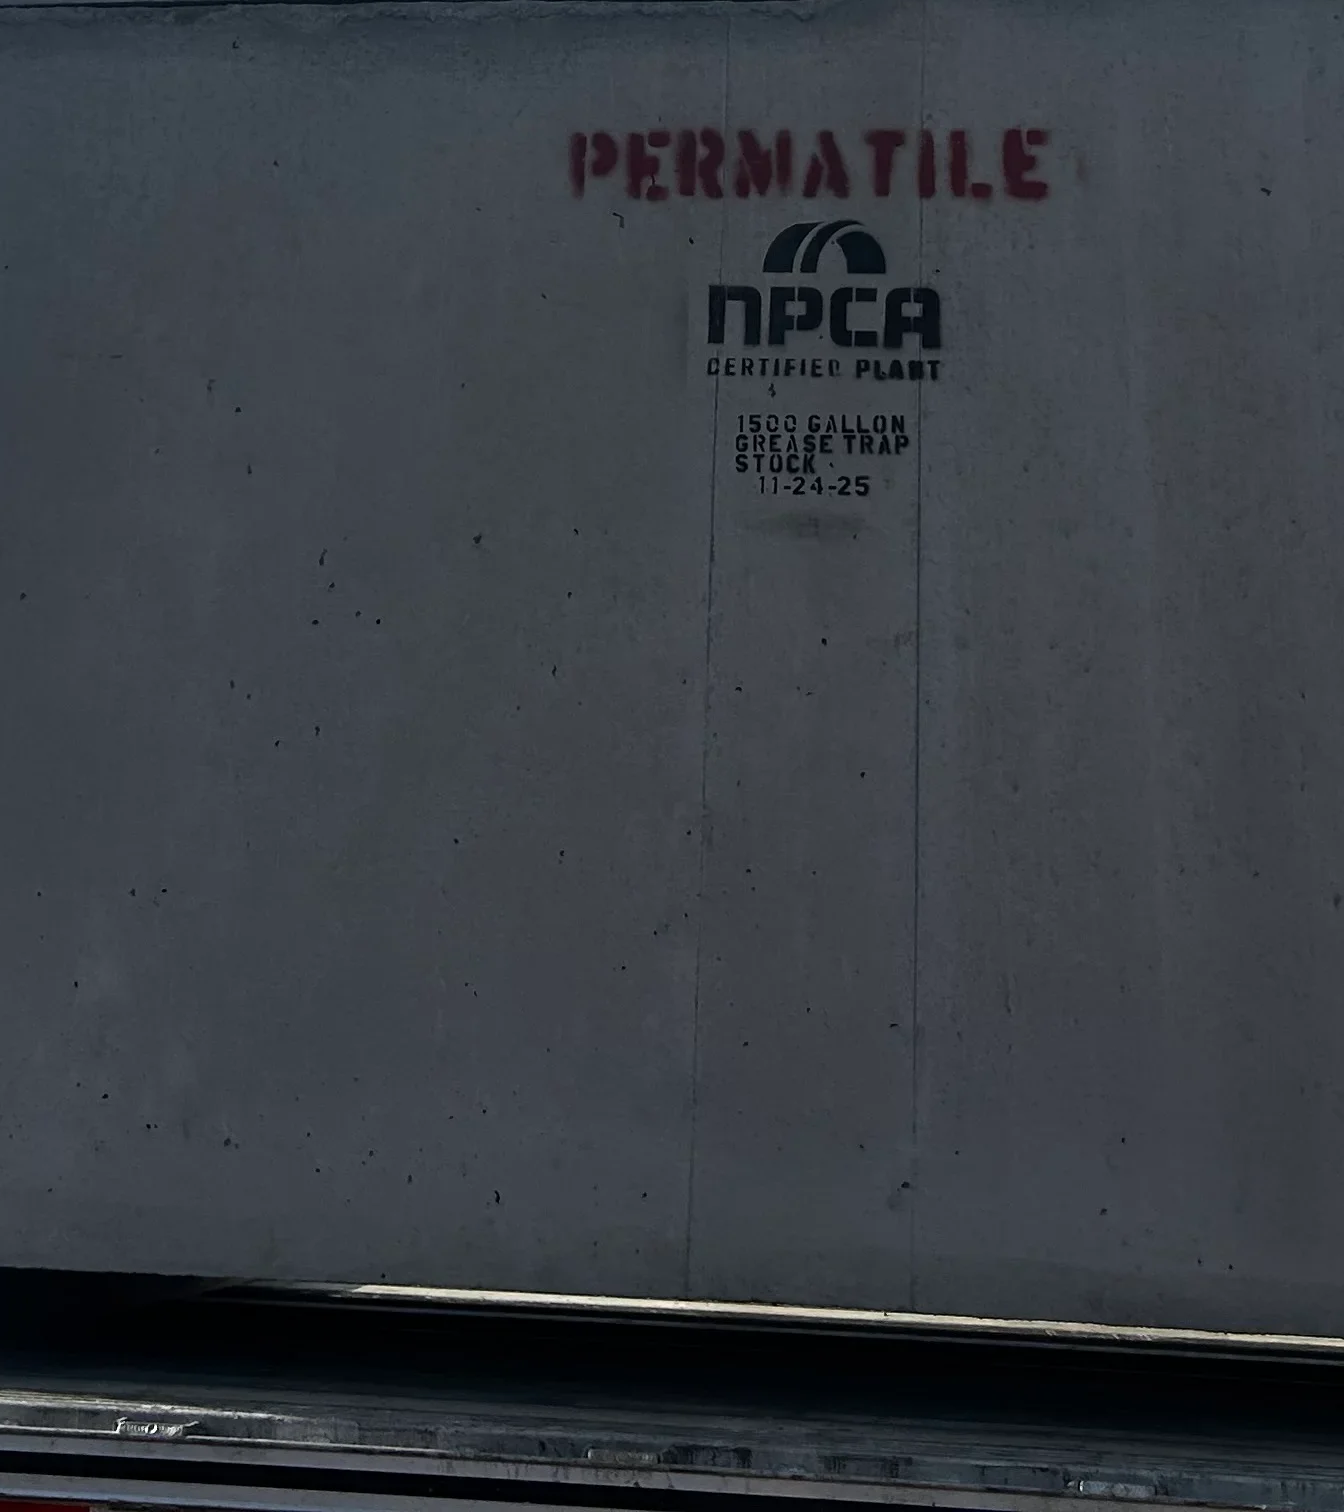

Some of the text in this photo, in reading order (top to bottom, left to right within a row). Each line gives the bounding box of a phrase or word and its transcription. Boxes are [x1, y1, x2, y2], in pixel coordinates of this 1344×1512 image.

[569, 128, 1052, 201] PERMATILE
[706, 357, 942, 381] CERTIFIED PLANT
[736, 414, 906, 434] 1500 GALLON
[735, 434, 910, 455] GREASE TRAP
[735, 453, 817, 474] STOCK
[758, 476, 871, 496] 11-24-25
